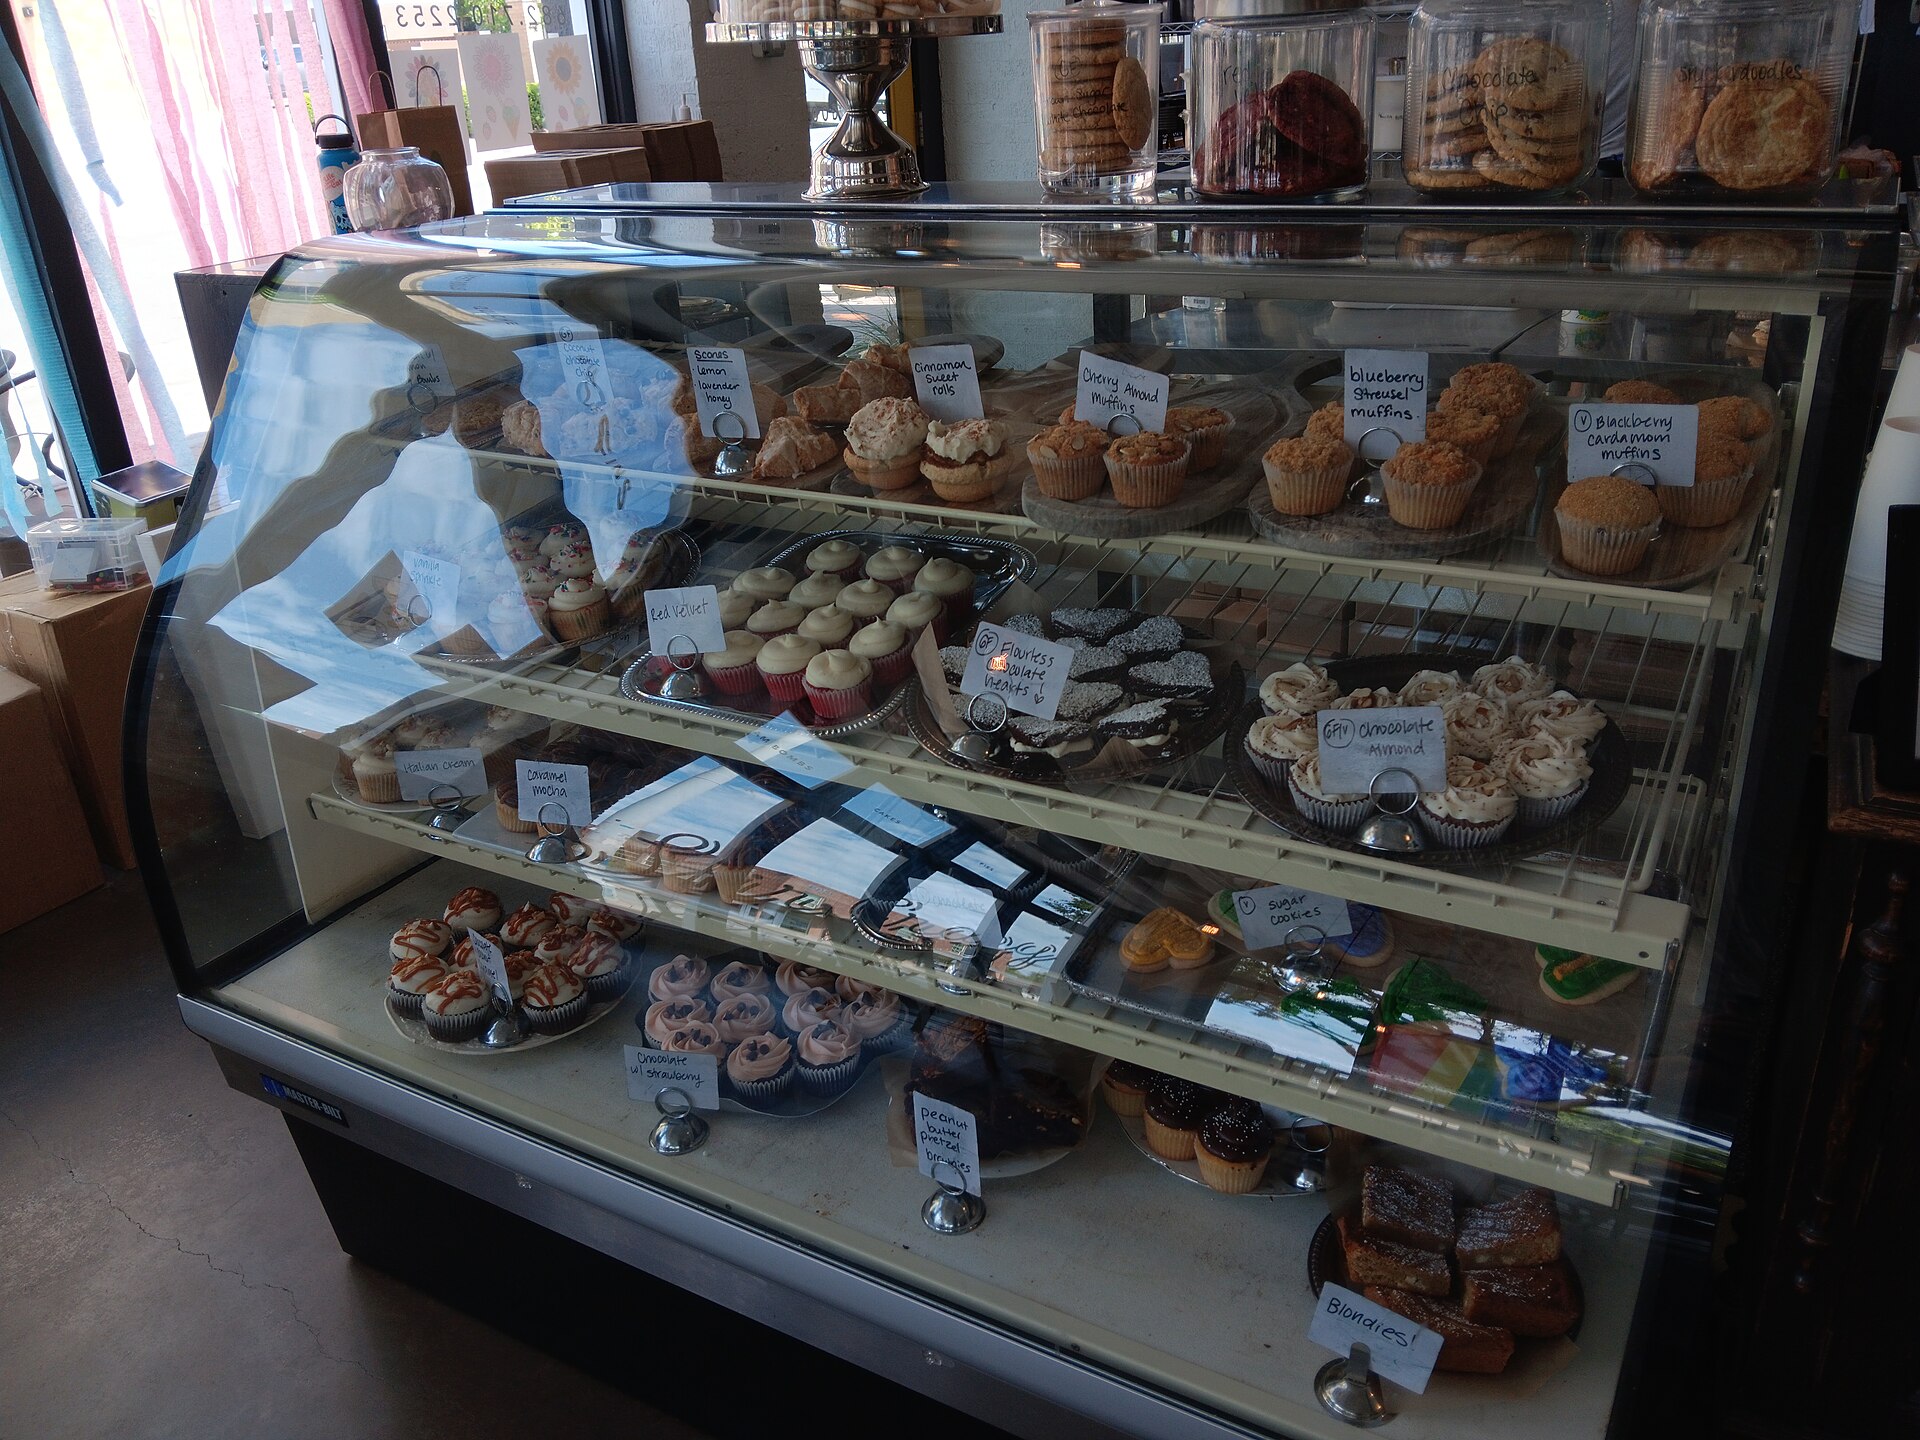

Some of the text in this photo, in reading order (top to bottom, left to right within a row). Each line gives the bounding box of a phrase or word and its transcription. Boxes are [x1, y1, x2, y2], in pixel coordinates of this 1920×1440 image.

[698, 380, 740, 391] lavender
[1082, 367, 1159, 403] Cherry Almond
[1350, 365, 1424, 393] blueberry
[932, 383, 956, 396] rolls
[705, 391, 733, 410] honey
[1601, 446, 1662, 461] muffins
[650, 604, 671, 622] Red
[1000, 641, 1056, 668] Flourless
[646, 1067, 705, 1088] strawberry
[926, 1121, 961, 1140] butter
[1326, 1297, 1417, 1352] Blondies!
